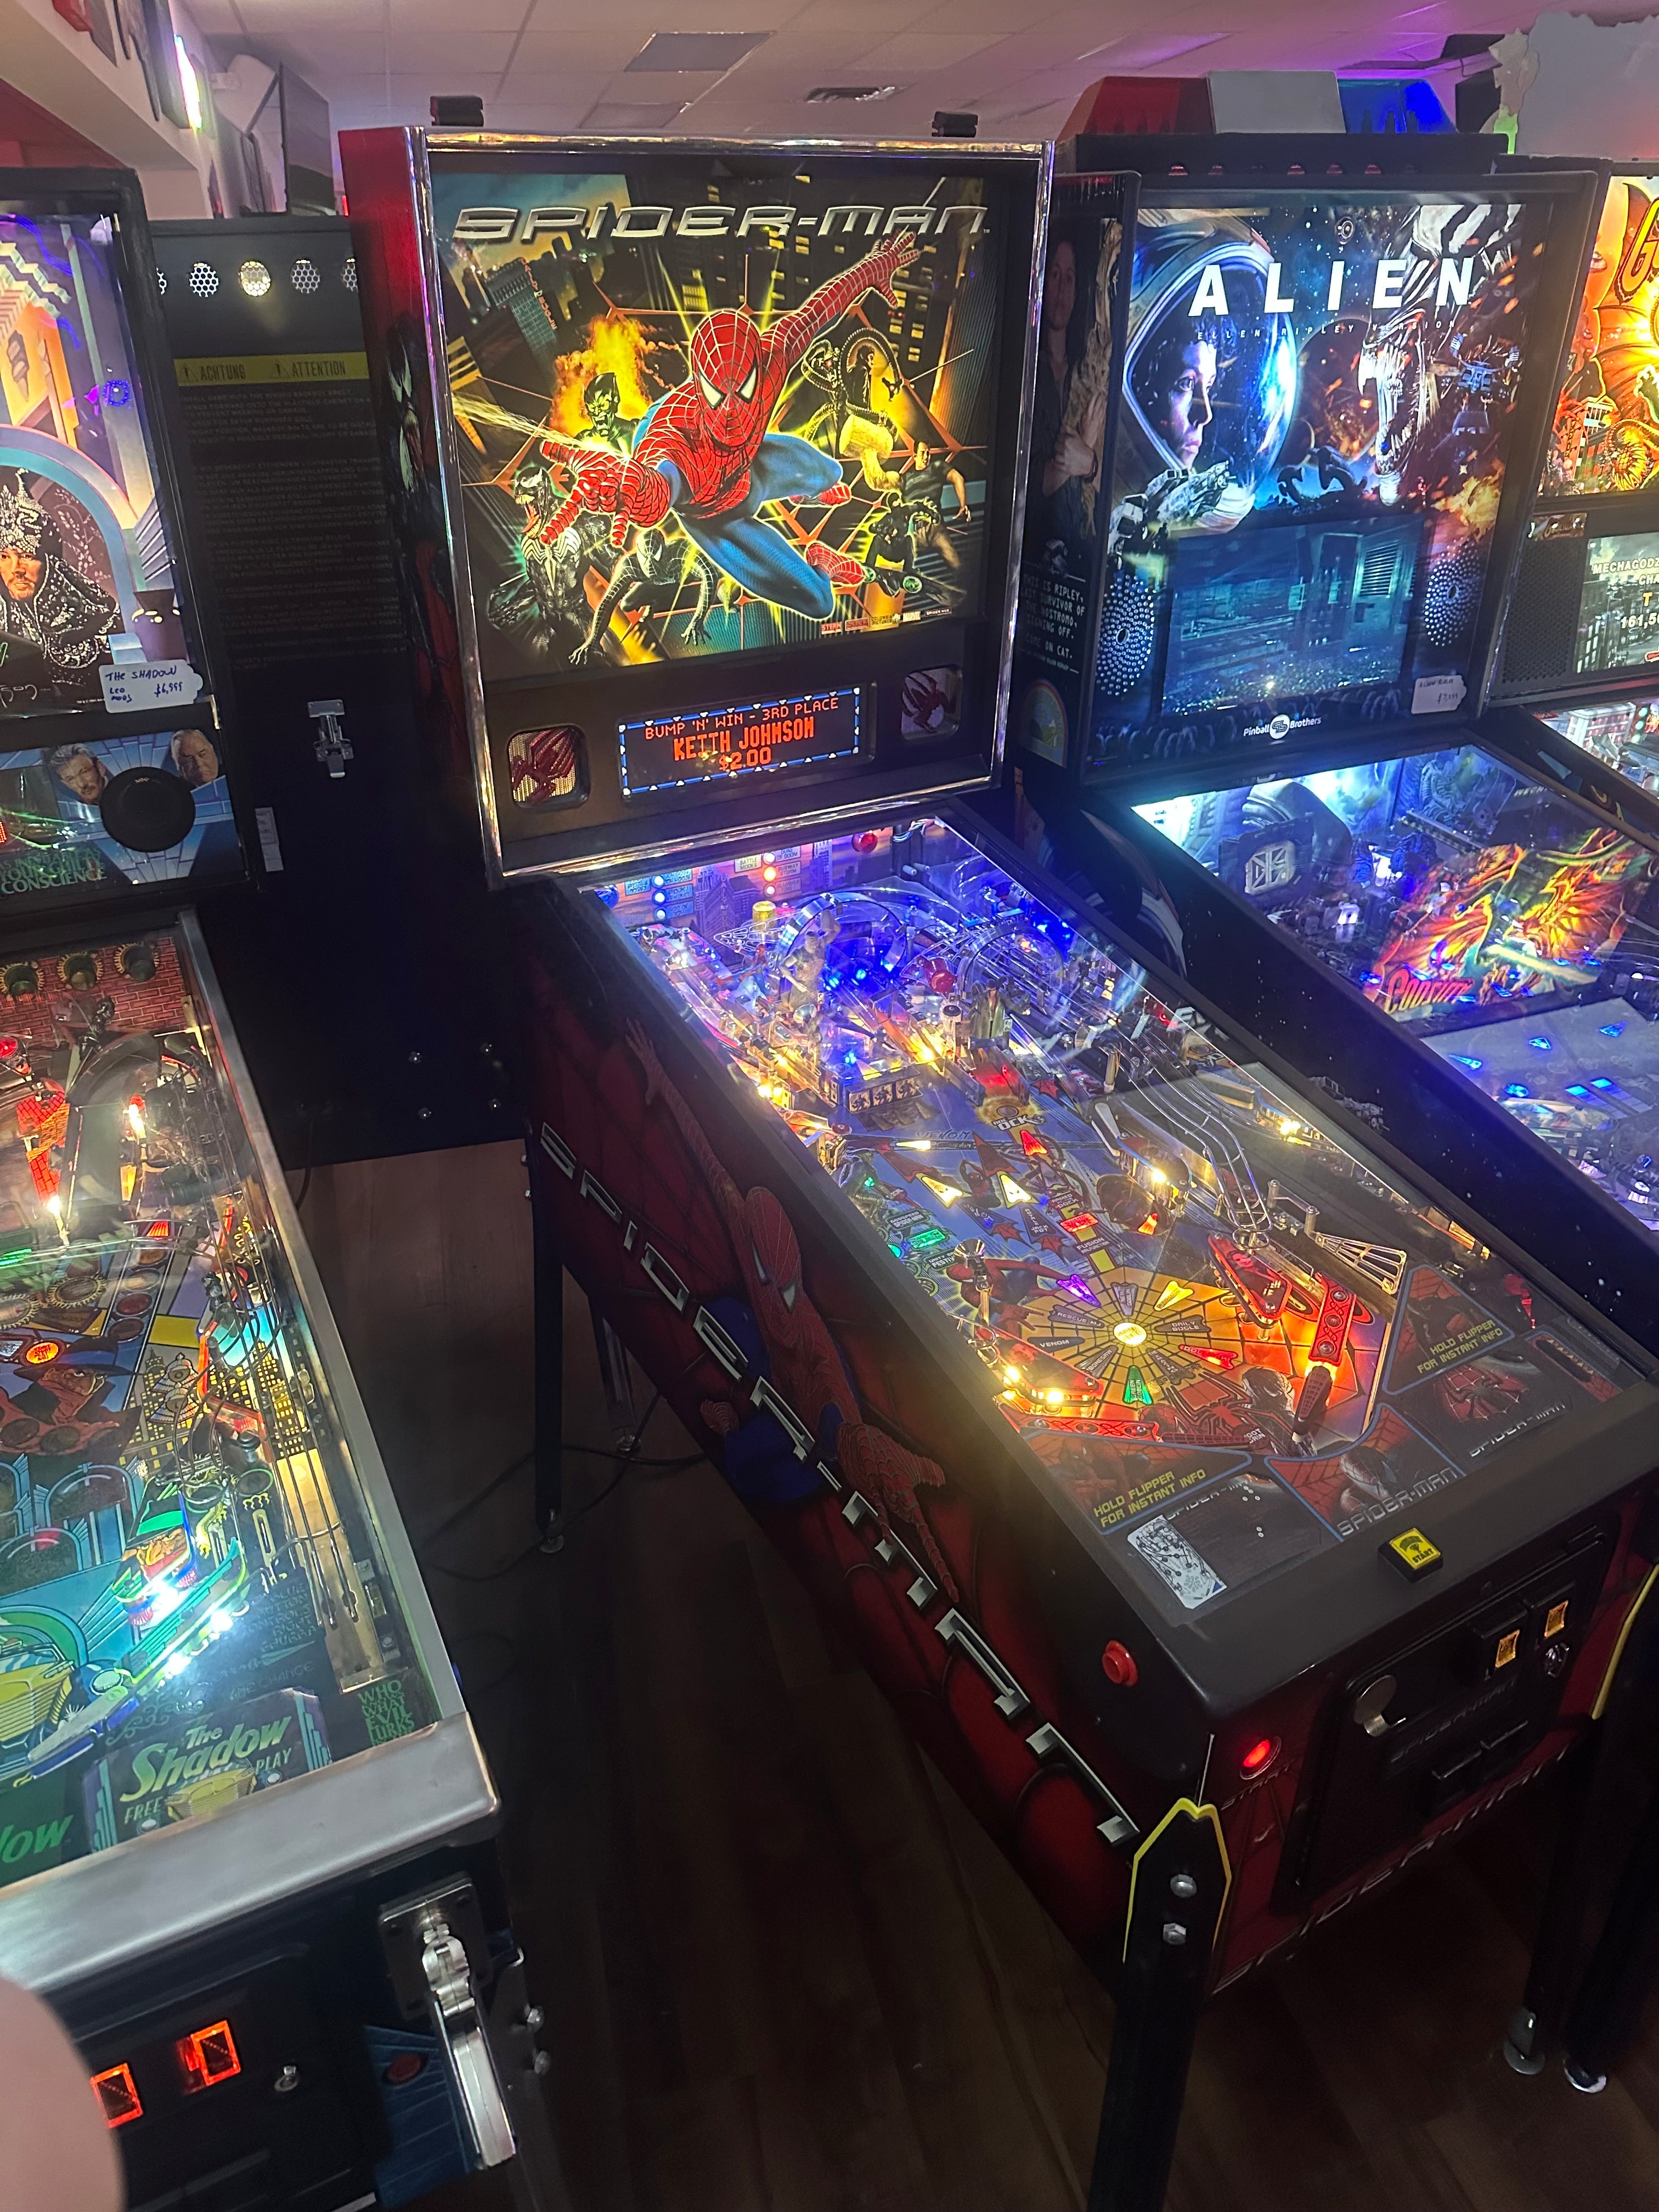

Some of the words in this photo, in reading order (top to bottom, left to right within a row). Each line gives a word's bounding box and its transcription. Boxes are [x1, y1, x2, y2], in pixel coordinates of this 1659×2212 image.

[452, 205, 988, 240] SPIDER-MAN
[1188, 257, 1474, 317] ALIEN
[1198, 329, 1261, 340] ELLEN
[1281, 325, 1355, 336] RIPLEY
[1372, 320, 1456, 332] VERSION
[201, 364, 246, 381] ACHTUNG
[292, 360, 346, 377] ATTENTION
[1054, 584, 1084, 603] RIPLEY,
[1040, 593, 1073, 613] SURVIVOR
[1076, 607, 1085, 616] OF
[822, 623, 842, 631] STERN
[1041, 607, 1077, 628] NOSTROMO,
[1058, 627, 1074, 639] OFF.
[1045, 641, 1053, 652] ON
[1057, 645, 1073, 658] CAT.
[131, 665, 177, 679] SHADOW
[645, 723, 686, 740] BUMP
[715, 713, 743, 728] WIN
[762, 706, 789, 720] 3RD
[794, 697, 839, 715] PLACE
[1243, 723, 1269, 737] Pinball
[1290, 717, 1322, 729] Brothers
[673, 731, 731, 761] KEITH
[738, 716, 815, 750] JOHNSON
[740, 857, 758, 865] BATTLE
[778, 863, 799, 871] SUBWAY
[997, 1114, 1029, 1131] OCK
[917, 1128, 973, 1141] VENOM
[1076, 1237, 1105, 1250] FUSION
[932, 1255, 955, 1268] FESTIV
[1057, 1312, 1087, 1324] RESCUE
[1039, 1339, 1070, 1348] VENOM
[1430, 1336, 1457, 1355] HOLD
[1457, 1319, 1497, 1341] FLIPPER
[1183, 1345, 1203, 1354] DOC
[1417, 1358, 1438, 1374] FOR
[1440, 1338, 1479, 1364] INSTANT
[1480, 1328, 1504, 1344] INFO
[1093, 1494, 1126, 1517] HOLD
[1128, 1471, 1175, 1500] FLIPPER
[1100, 1507, 1126, 1528] FOR
[1128, 1483, 1176, 1514] INSTANT
[1180, 1469, 1206, 1488] INFO
[1336, 1466, 1459, 1537] SPIDER-MAN
[1412, 1548, 1435, 1563] START
[273, 1616, 312, 1636] RIGHT
[258, 1661, 315, 1688] CHANGE
[358, 1679, 402, 1705] WHO
[362, 1692, 405, 1718] WHAT
[365, 1705, 407, 1730] EVIL
[185, 1725, 223, 1751] The
[119, 1714, 292, 1803] Shadow
[123, 1798, 167, 1824] FREE
[255, 1746, 293, 1775] PLAY
